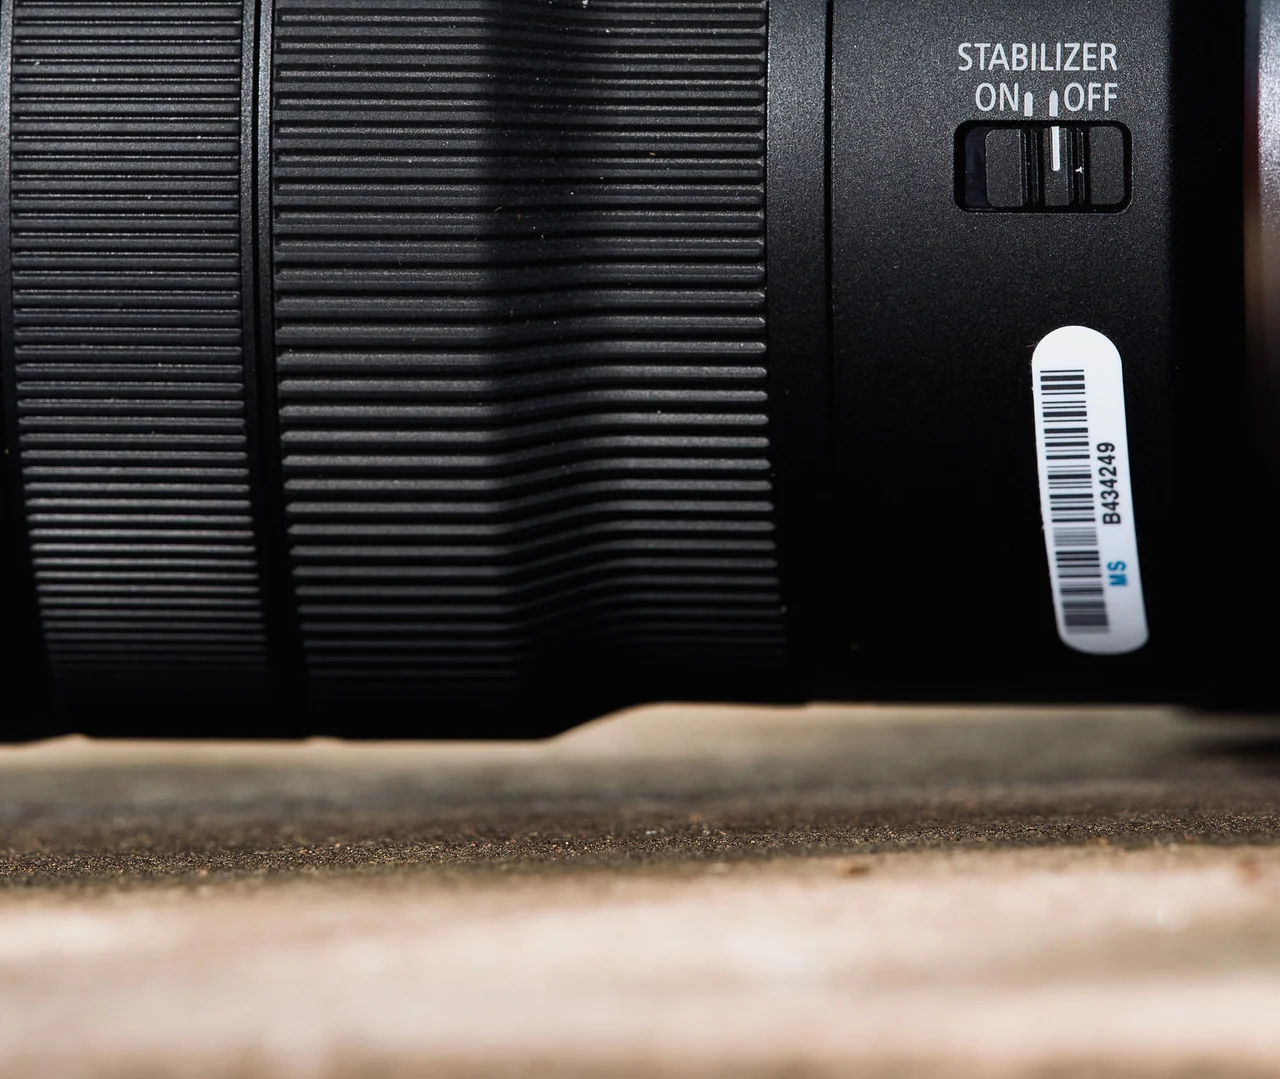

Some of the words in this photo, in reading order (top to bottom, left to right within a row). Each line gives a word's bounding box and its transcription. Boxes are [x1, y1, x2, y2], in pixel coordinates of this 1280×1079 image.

[957, 41, 1119, 72] STABILIZER
[974, 81, 1019, 113] ON
[1063, 81, 1119, 113] OFF
[1096, 442, 1122, 525] B434249
[1106, 560, 1128, 588] MS
